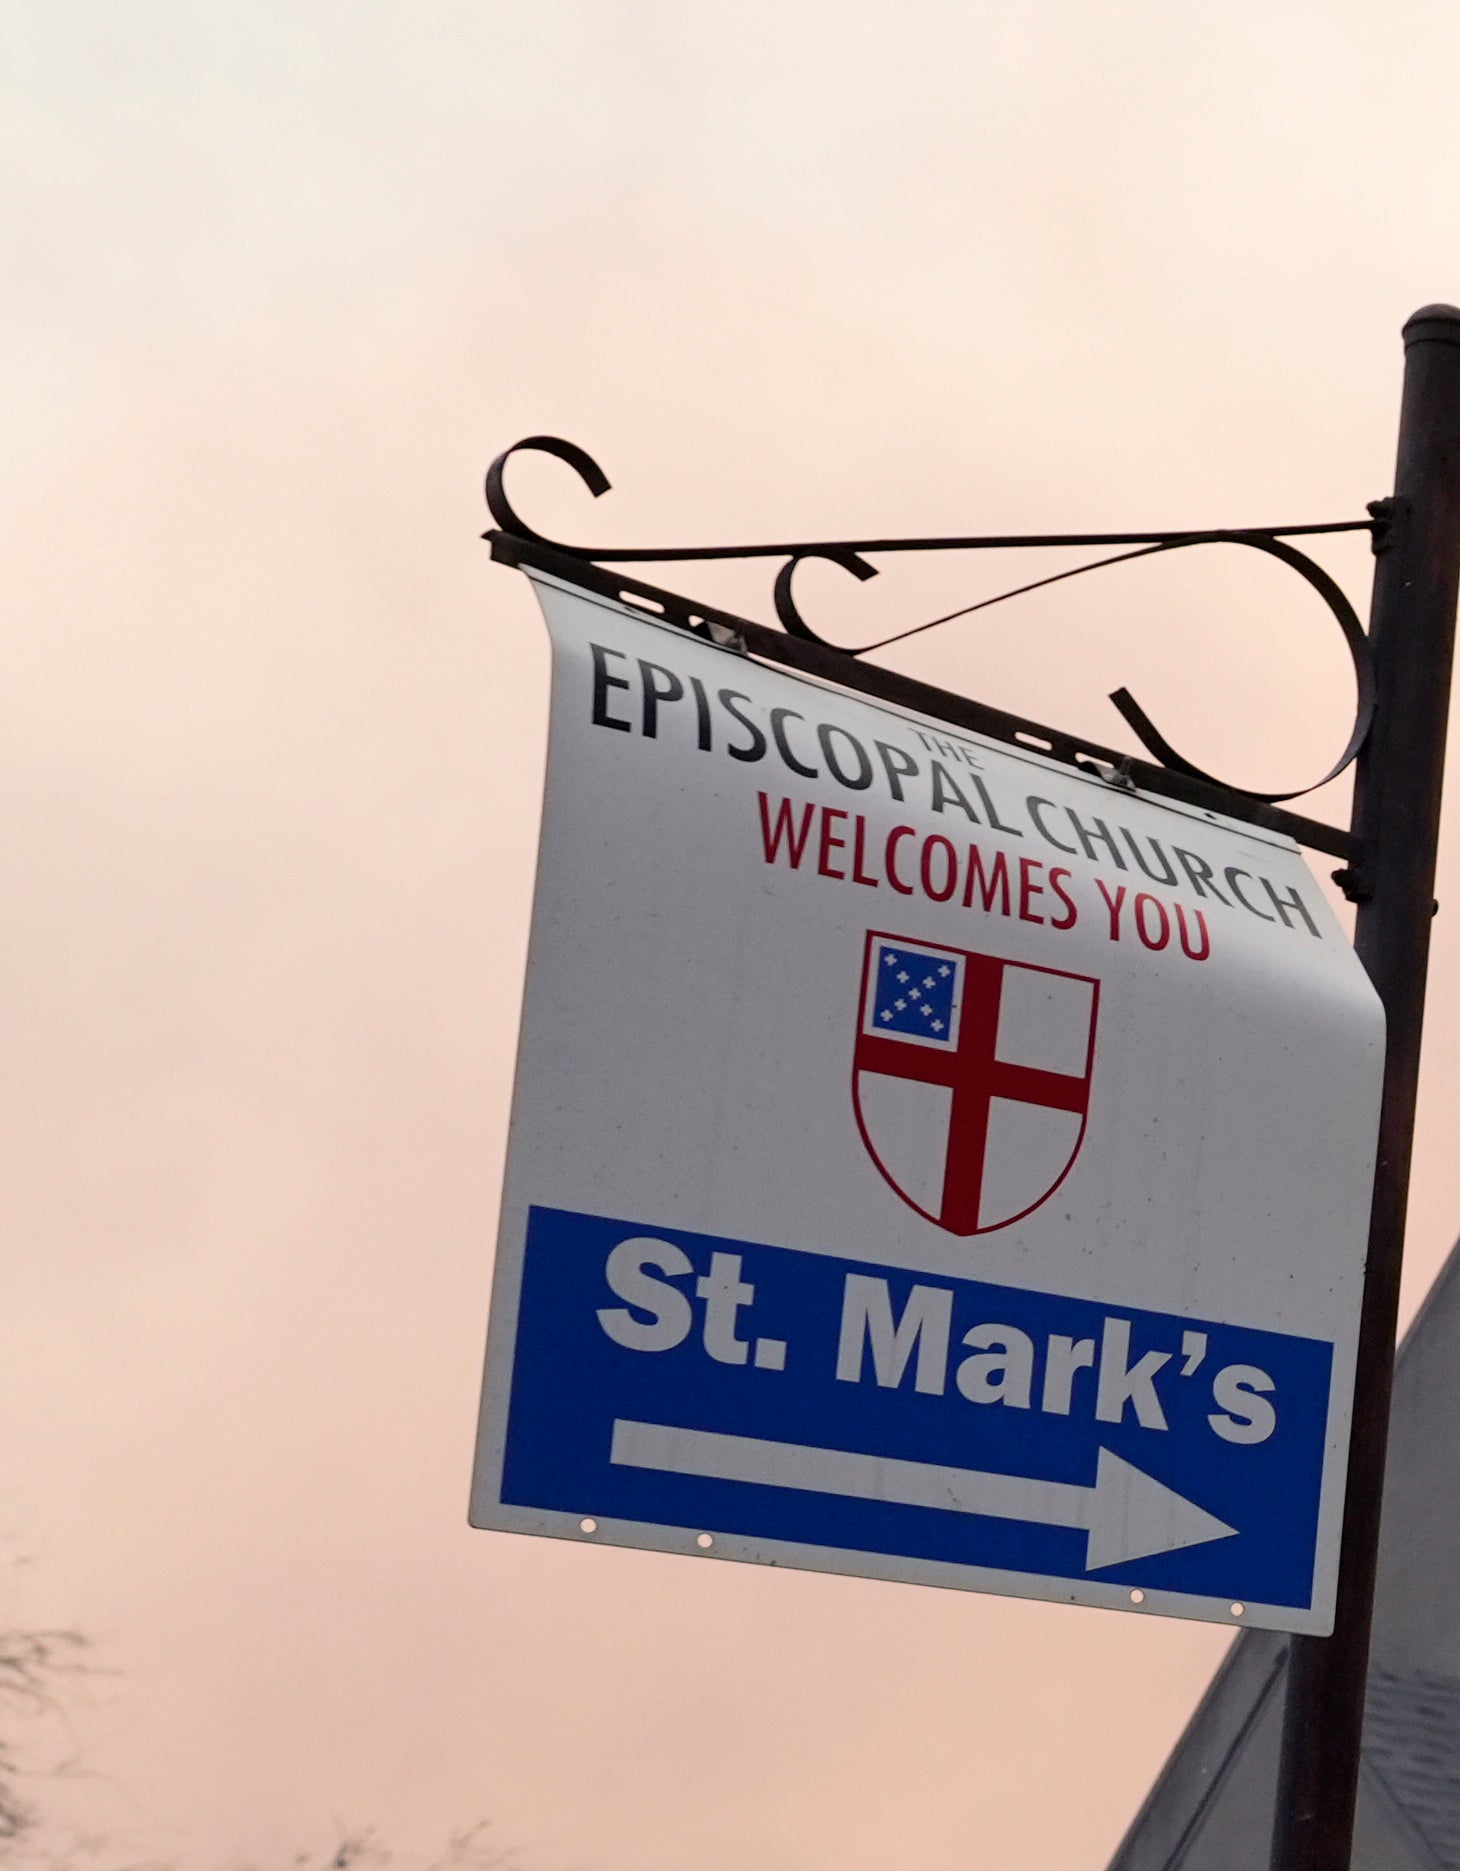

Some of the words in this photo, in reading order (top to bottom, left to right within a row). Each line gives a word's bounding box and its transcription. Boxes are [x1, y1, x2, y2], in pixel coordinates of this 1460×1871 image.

[588, 641, 1025, 838] EPISCOPAL
[1025, 795, 1324, 939] CHURCH
[907, 726, 985, 771] THE
[756, 790, 1078, 931] WELCOMES
[1094, 878, 1211, 962] YOU
[595, 1236, 788, 1371] St.
[834, 1273, 1278, 1446] Mark's
